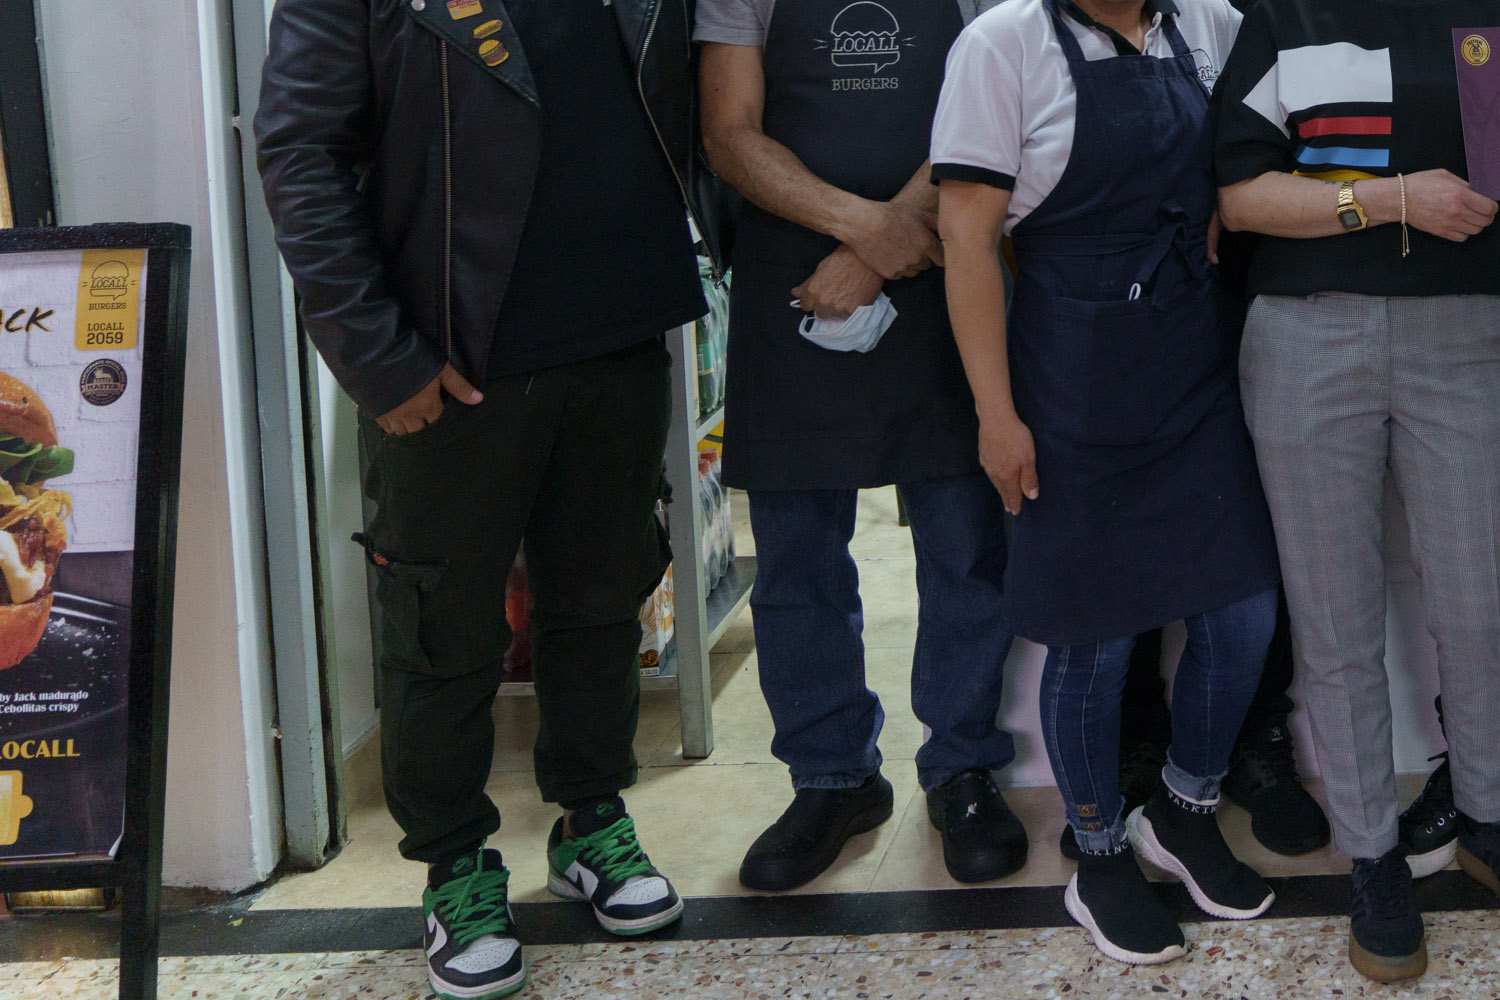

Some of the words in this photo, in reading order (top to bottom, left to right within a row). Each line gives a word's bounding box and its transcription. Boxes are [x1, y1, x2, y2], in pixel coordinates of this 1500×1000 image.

[832, 36, 899, 52] LOCALL
[832, 77, 899, 91] BURGERS
[90, 277, 128, 289] LOCALL
[88, 301, 126, 311] BURGERS
[0, 306, 55, 333] CK
[87, 323, 125, 332] LOCALL
[87, 332, 124, 345] 2059
[13, 692, 37, 702] Jack
[38, 690, 89, 702] madurado
[48, 702, 80, 713] crispy
[0, 738, 81, 760] OCALL
